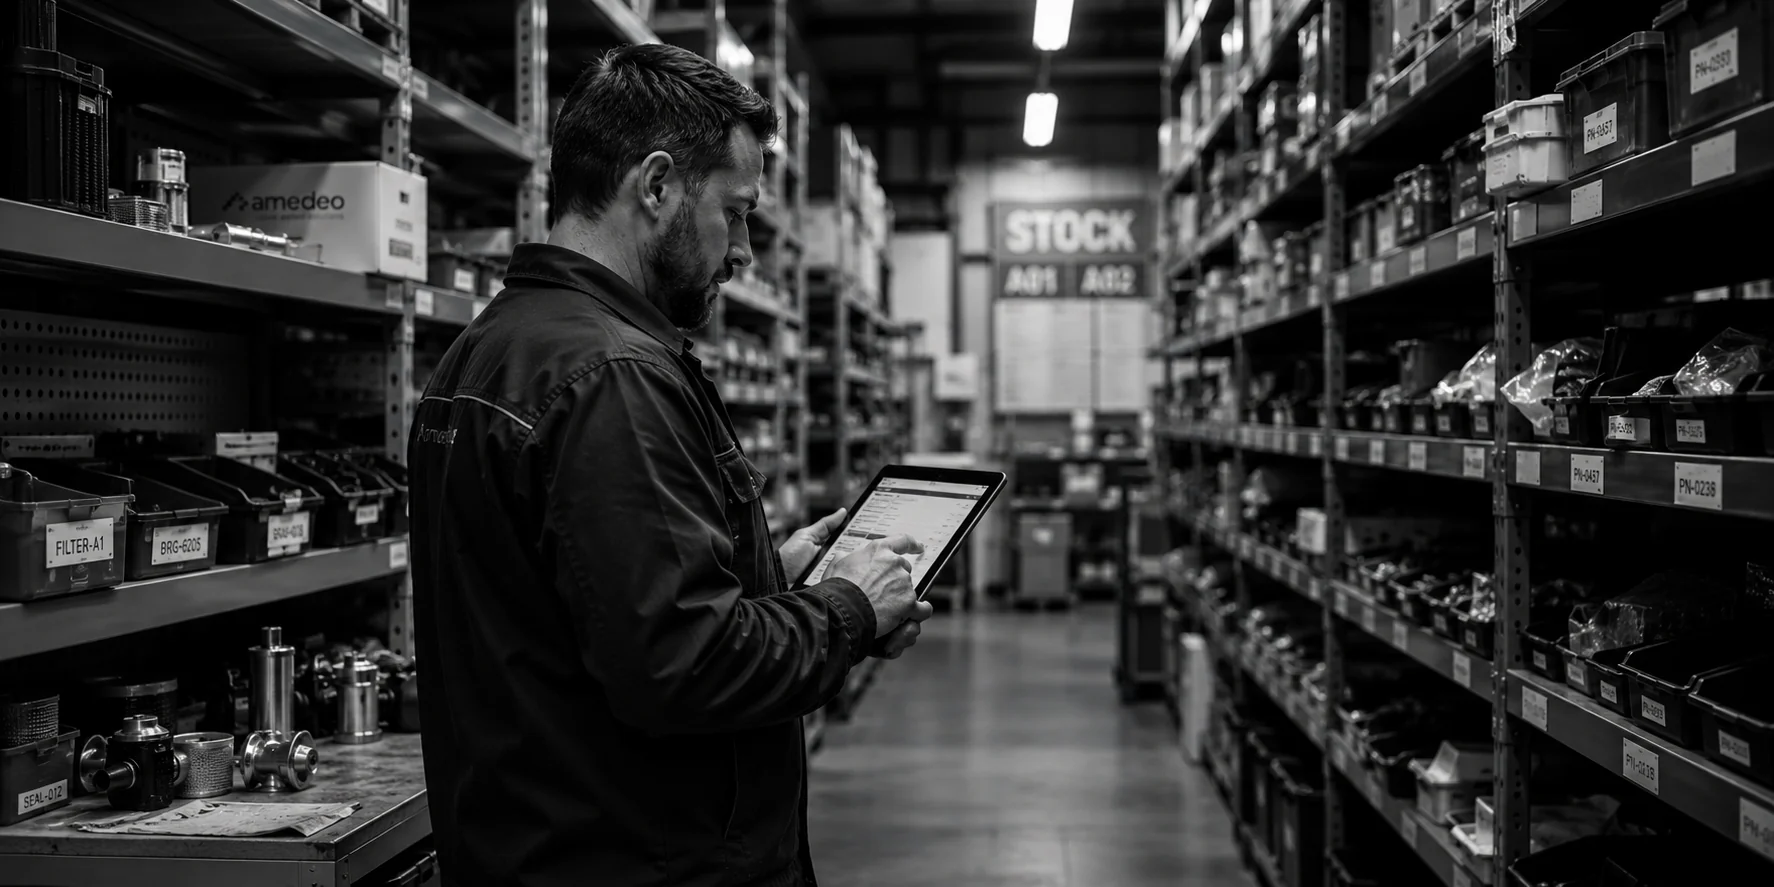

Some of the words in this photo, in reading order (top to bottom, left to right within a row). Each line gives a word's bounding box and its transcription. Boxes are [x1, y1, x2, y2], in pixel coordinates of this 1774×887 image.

[252, 192, 344, 210] amedeo
[1006, 208, 1136, 254] STOCK
[1004, 265, 1057, 296] A01
[1080, 265, 1137, 296] A02
[56, 536, 104, 557] FILTER-A1
[160, 537, 202, 556] BRG-6205
[23, 785, 63, 810] SEAL-012
